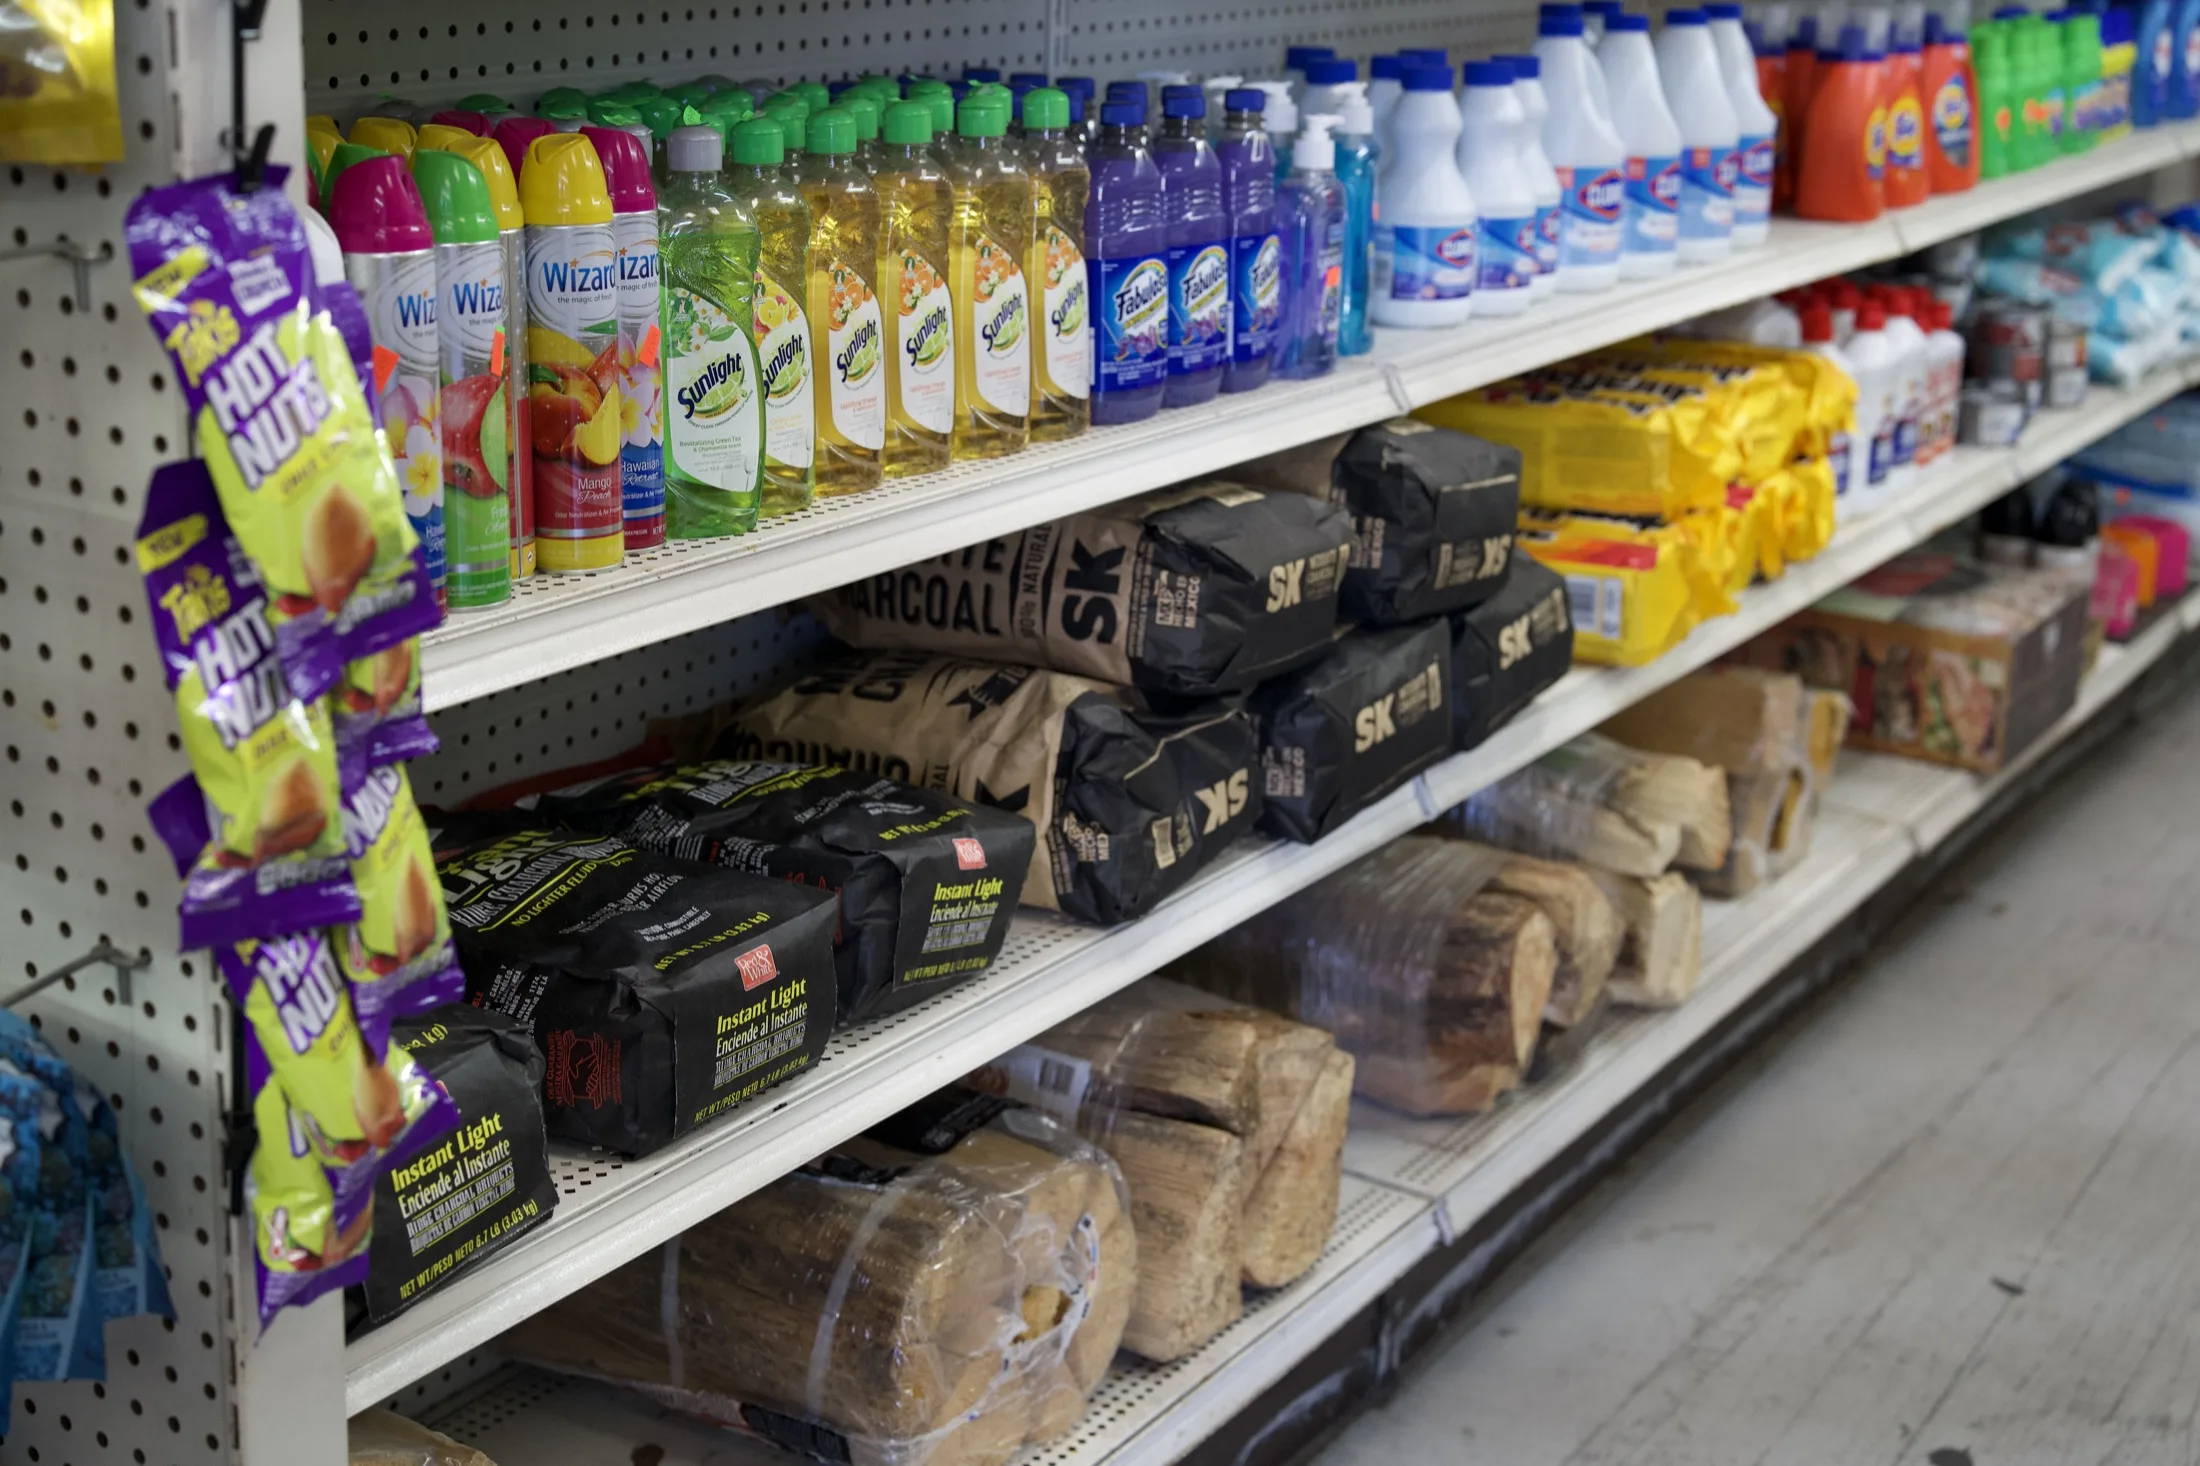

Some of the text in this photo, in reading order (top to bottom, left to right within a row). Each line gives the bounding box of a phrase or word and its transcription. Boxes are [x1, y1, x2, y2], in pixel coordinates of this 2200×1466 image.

[557, 296, 570, 304] the
[571, 297, 592, 305] magic
[621, 284, 640, 292] magic
[1051, 280, 1084, 338] Sunlight
[836, 319, 877, 384] Sunlight
[906, 306, 947, 367] Sunlight
[981, 293, 1022, 352] Sunlight
[204, 320, 289, 434] HOT
[677, 352, 742, 420] Sunlight
[229, 356, 333, 493] NUTS
[715, 436, 732, 445] Green
[576, 489, 611, 505] Peach
[577, 477, 612, 491] Mango
[555, 511, 568, 519] Odor
[852, 567, 1003, 638] ARCOAL
[1061, 537, 1127, 645] SK
[1266, 558, 1305, 614] SK
[194, 596, 276, 693] HOT
[1498, 612, 1533, 671] SK
[205, 652, 291, 750] NUT
[1354, 692, 1397, 754] SK
[1194, 767, 1250, 836] SK
[487, 851, 577, 902] CHARCOAL
[510, 914, 532, 928] NO
[529, 883, 573, 917] LIGHTER
[567, 861, 598, 888] FLUID
[933, 877, 1004, 902] Instant Light
[929, 902, 962, 924] Enciende
[715, 1001, 808, 1058] Enciende al Instante
[716, 977, 807, 1035] Instant Light
[737, 1039, 772, 1063] CHARCOAL
[773, 1021, 806, 1048] BRIQUETS
[694, 1106, 709, 1123] NET
[709, 1088, 741, 1115] WT/PESO
[742, 1080, 759, 1098] NETO
[390, 1112, 503, 1193] Instant Light
[397, 1139, 511, 1219] Enciende al Instante
[406, 1161, 514, 1238] RIDGE CHARCOAL BRIQUETS
[399, 1198, 539, 1300] NET WT/PESO NETO 6.7 LB (3.03 kg)
